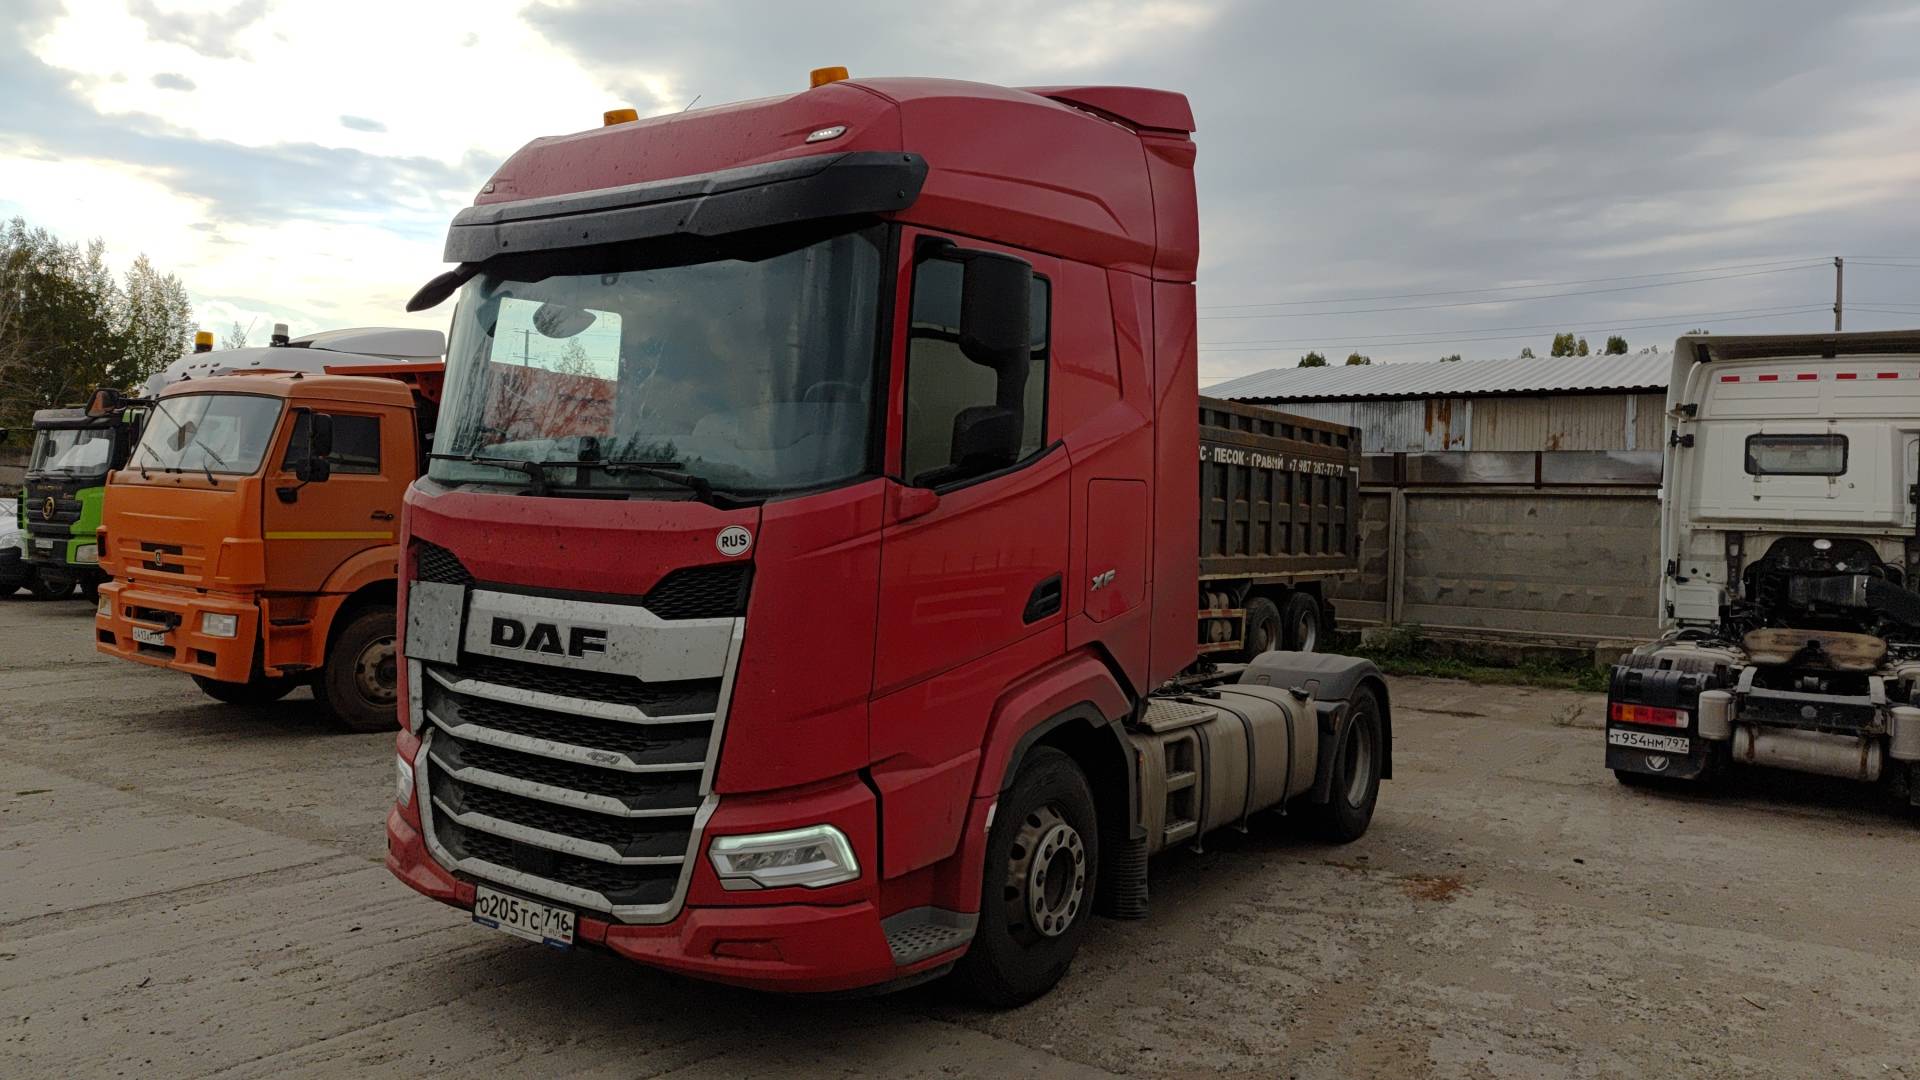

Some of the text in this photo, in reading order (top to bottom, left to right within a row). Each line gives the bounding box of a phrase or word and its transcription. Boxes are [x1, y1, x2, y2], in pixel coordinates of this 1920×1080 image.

[1214, 447, 1245, 465] ПЕСОК
[1251, 453, 1284, 470] ГРАВИЙ
[721, 534, 747, 548] RUS
[1091, 569, 1116, 591] XF
[490, 616, 608, 659] DAF
